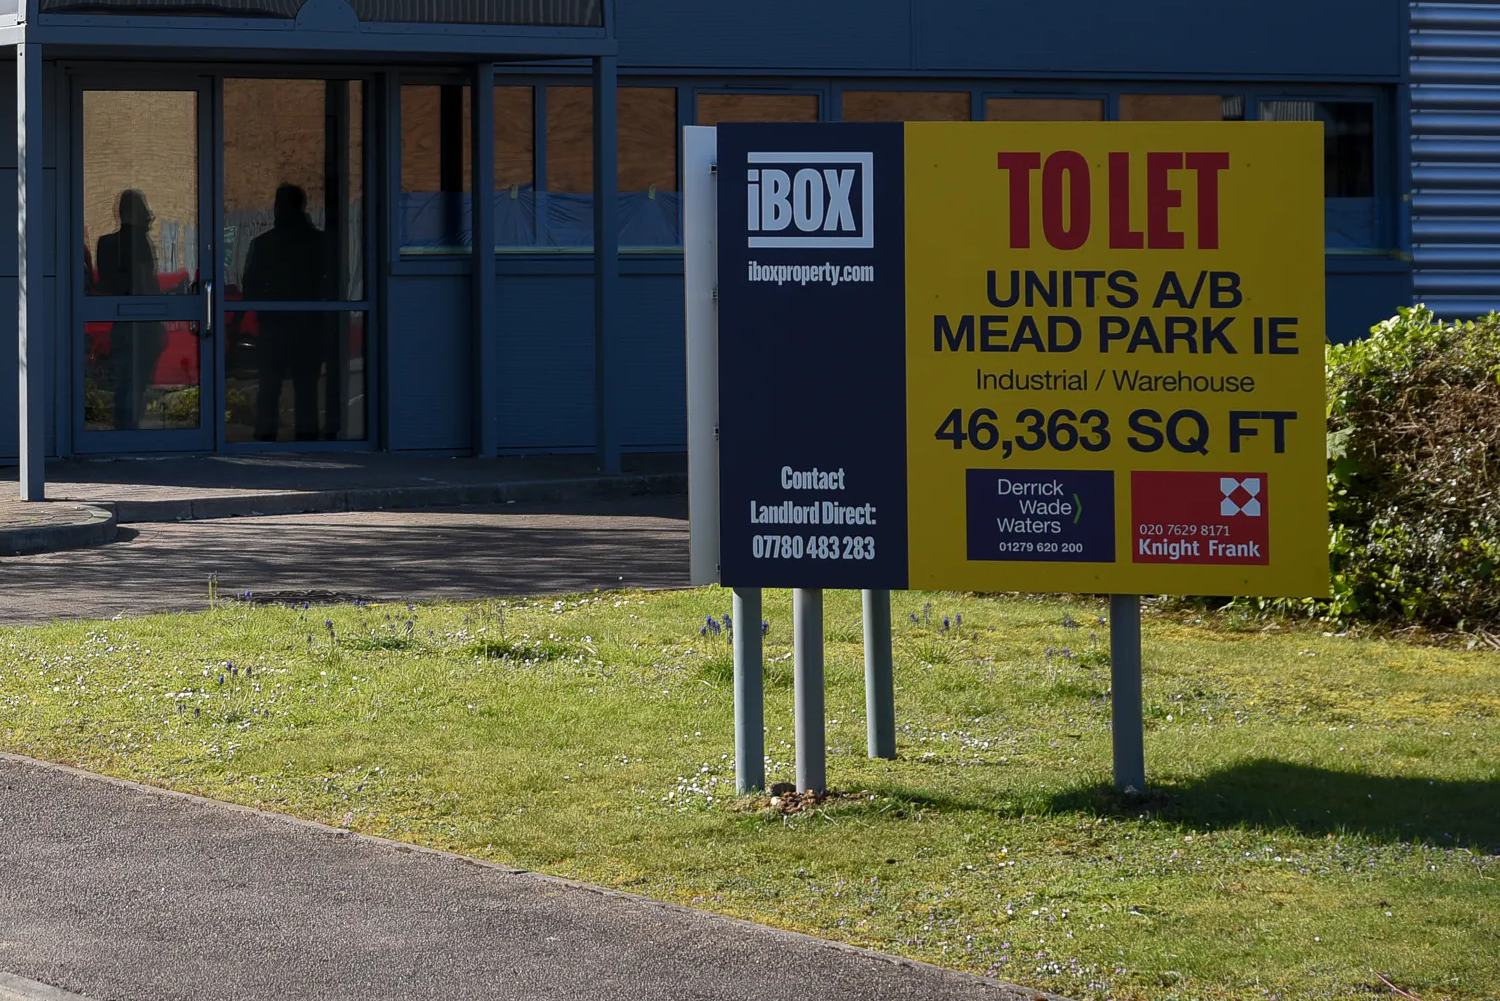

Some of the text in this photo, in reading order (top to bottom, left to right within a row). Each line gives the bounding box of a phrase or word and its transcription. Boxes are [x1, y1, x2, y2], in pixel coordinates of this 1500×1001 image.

[747, 167, 857, 232] iBOX
[998, 150, 1230, 251] TO LET
[748, 260, 874, 286] iboxproperty.com
[986, 269, 1243, 310] UNITS A/B
[933, 314, 1300, 355] MEAD PARK IE
[976, 368, 1256, 393] Industrial / Warehouse
[934, 407, 1298, 460] 46,363 SQ FT
[781, 465, 846, 490] Contact
[750, 500, 877, 525] Landlord Direct:
[1018, 498, 1072, 516] Wade
[996, 517, 1062, 534] Waters
[1139, 523, 1230, 537] 020 7629 8171
[752, 534, 876, 560] 07780 483 283
[999, 541, 1083, 553] 01279 620 200
[1139, 538, 1261, 560] Knight Frank
